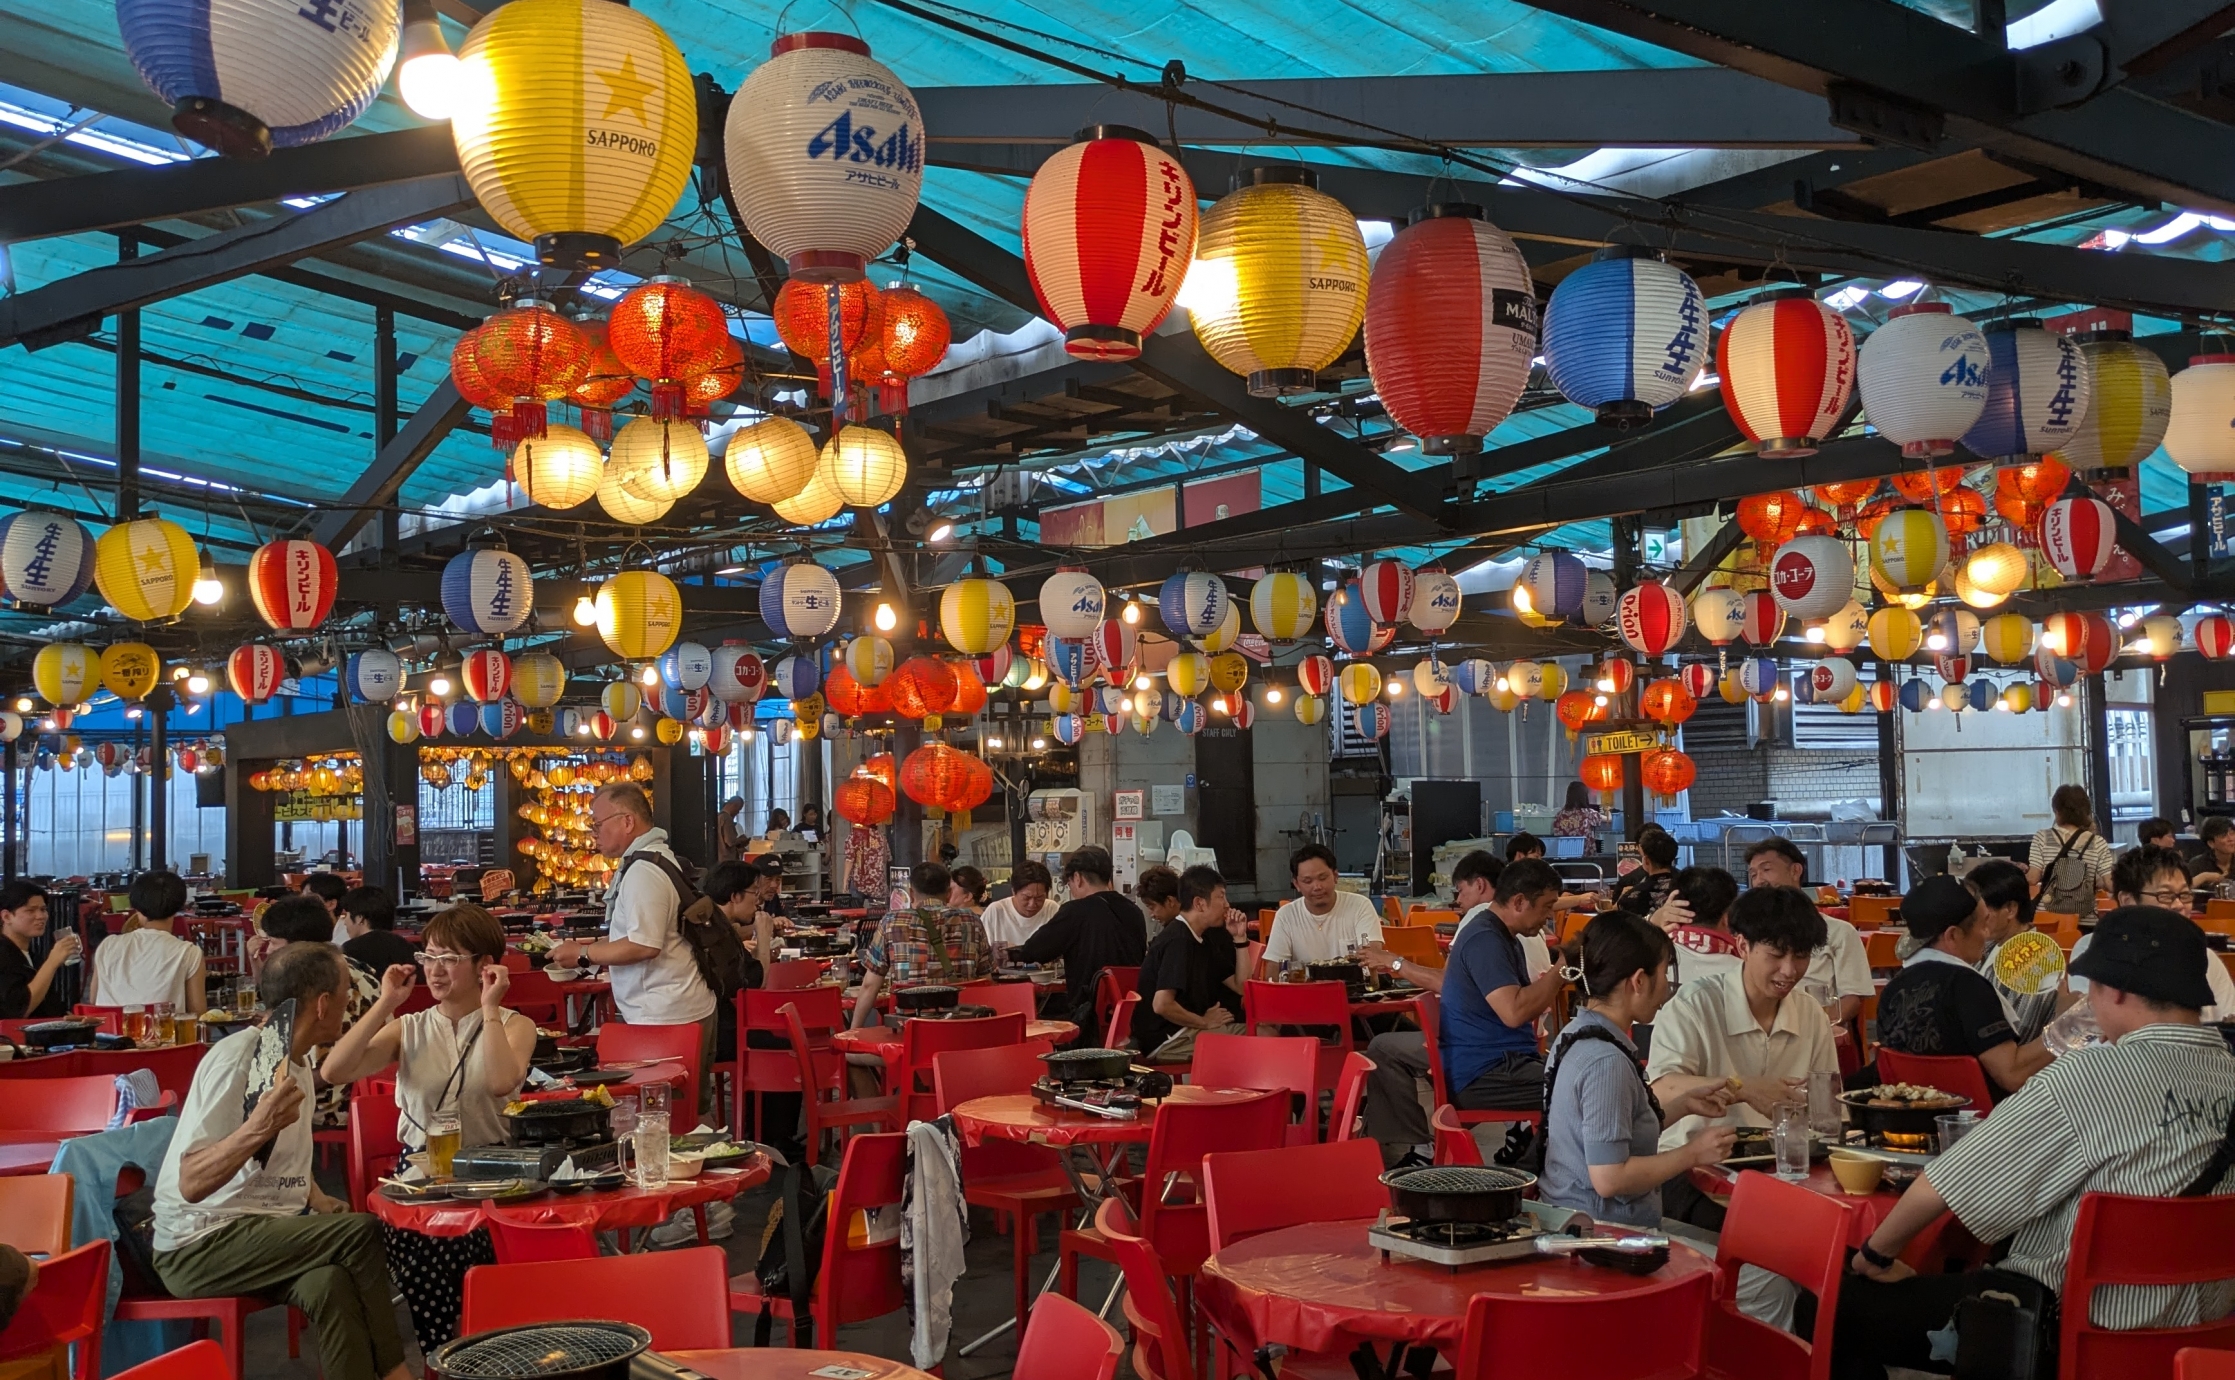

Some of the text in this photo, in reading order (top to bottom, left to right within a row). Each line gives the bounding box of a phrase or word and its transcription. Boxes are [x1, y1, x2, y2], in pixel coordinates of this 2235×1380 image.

[587, 129, 657, 157] SAPPORO
[845, 169, 900, 189] アサヒビール
[1141, 160, 1182, 297] キリンビール
[1308, 277, 1356, 293] SAPPORO
[830, 303, 844, 407] アサヒビール
[1823, 313, 1850, 415] キリンビール
[2051, 507, 2070, 564] キリンビール
[2210, 496, 2226, 551] アサヒビール
[23, 522, 63, 587] 生生生
[21, 584, 56, 593] SUNTORY
[140, 573, 174, 587] SAPPORO
[295, 549, 312, 613] キリンビール
[490, 558, 513, 616] 生生生
[1072, 596, 1103, 613] Asa
[1623, 594, 1640, 640] Orion
[258, 650, 269, 690] キリンビール
[490, 656, 501, 694] キリンビール
[1070, 652, 1078, 688] アサヒビール
[503, 702, 516, 729] Orion
[1376, 706, 1384, 732] Orion
[1202, 728, 1220, 738] STAFF
[1606, 734, 1640, 751] TOILET
[1115, 826, 1134, 838] 両替
[2003, 940, 2042, 969] マイアミ
